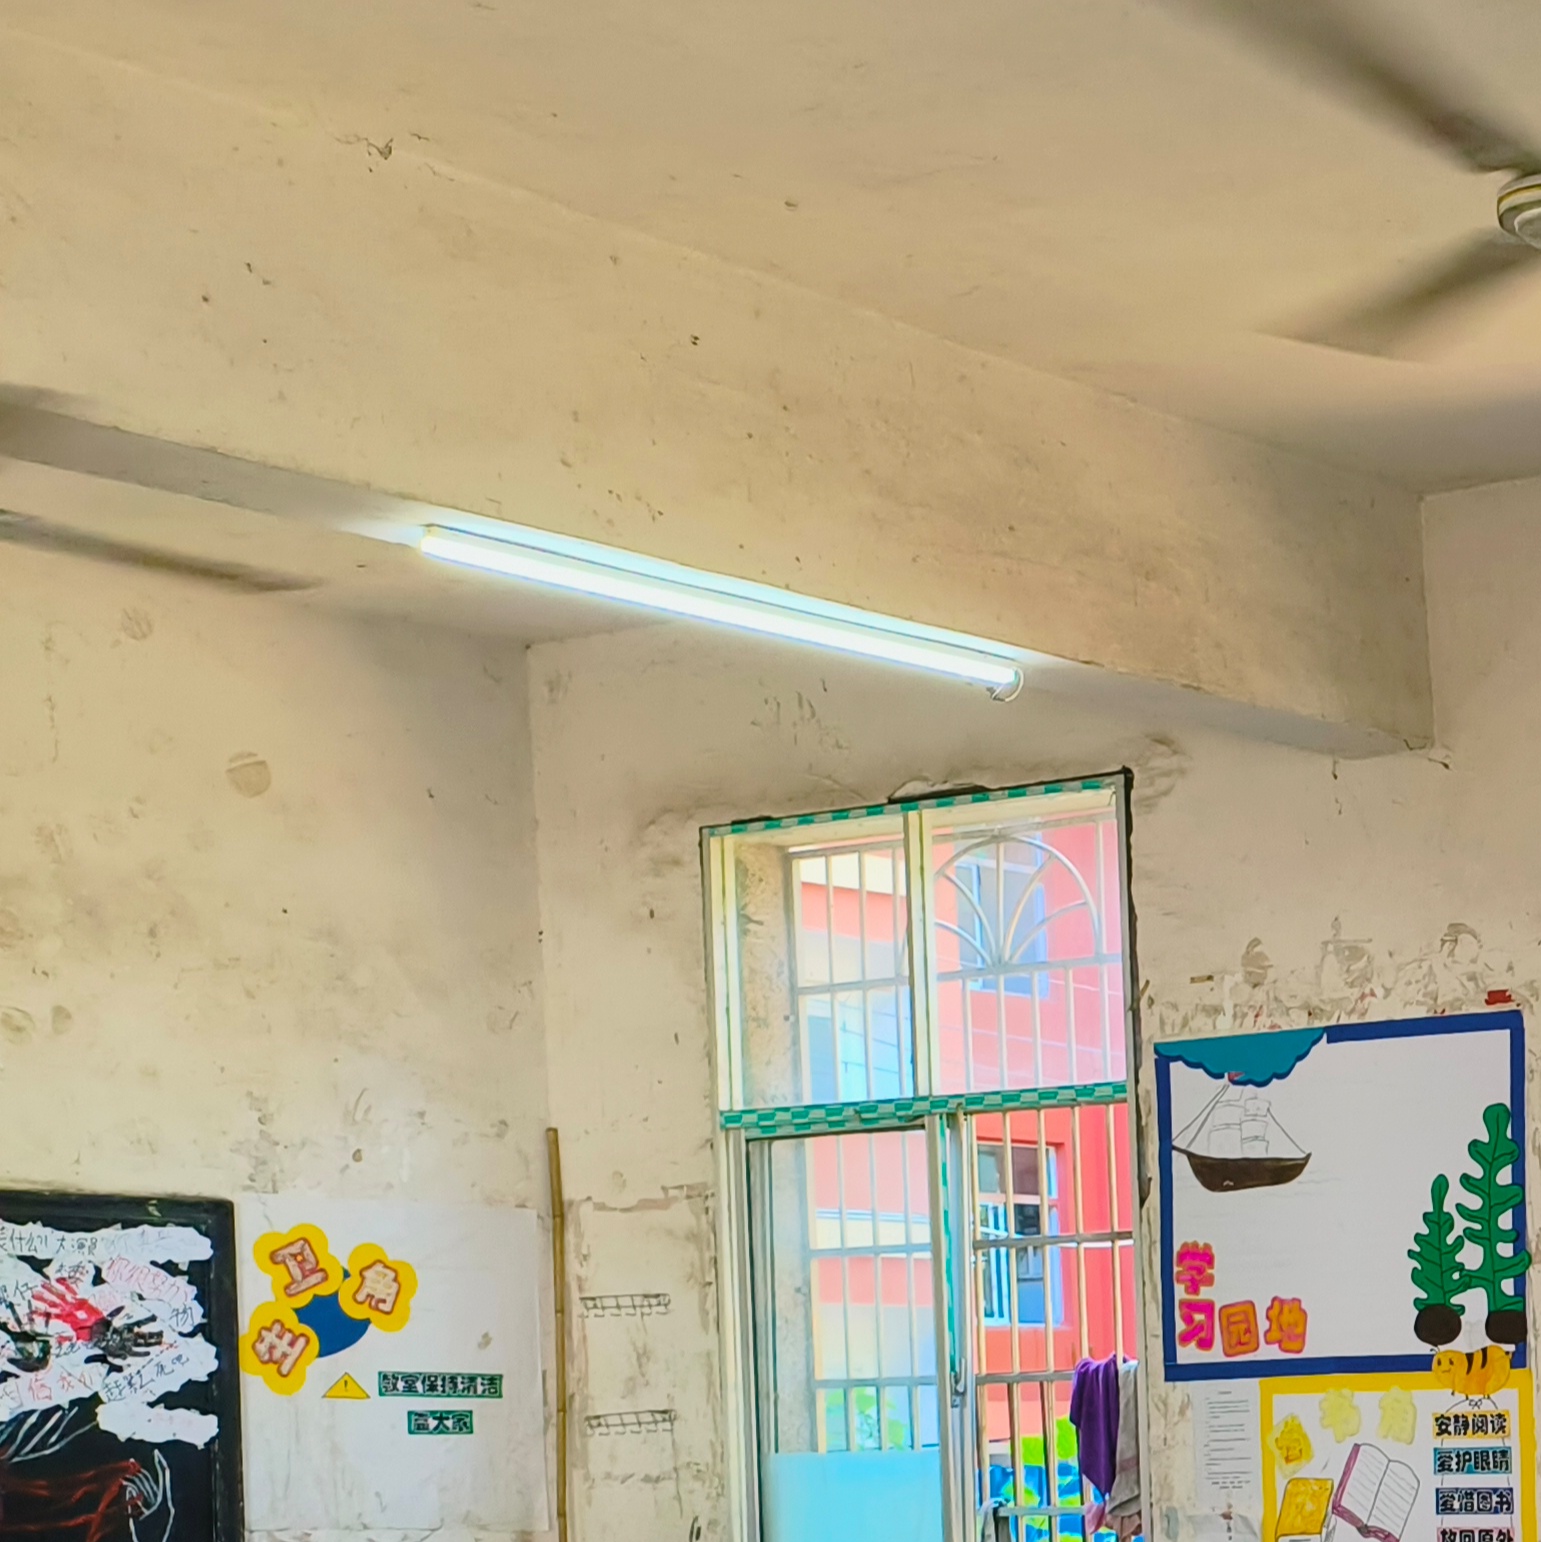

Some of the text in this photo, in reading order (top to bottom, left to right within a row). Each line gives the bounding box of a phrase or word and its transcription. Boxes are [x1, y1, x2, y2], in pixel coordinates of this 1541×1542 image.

[1174, 1240, 1308, 1357] 学习园地
[381, 1373, 500, 1397] 教室保持清洁
[1435, 1412, 1507, 1437] 安静阅读
[1437, 1450, 1510, 1473] 爱护眼睛
[1439, 1489, 1513, 1513] 爱惜图书
